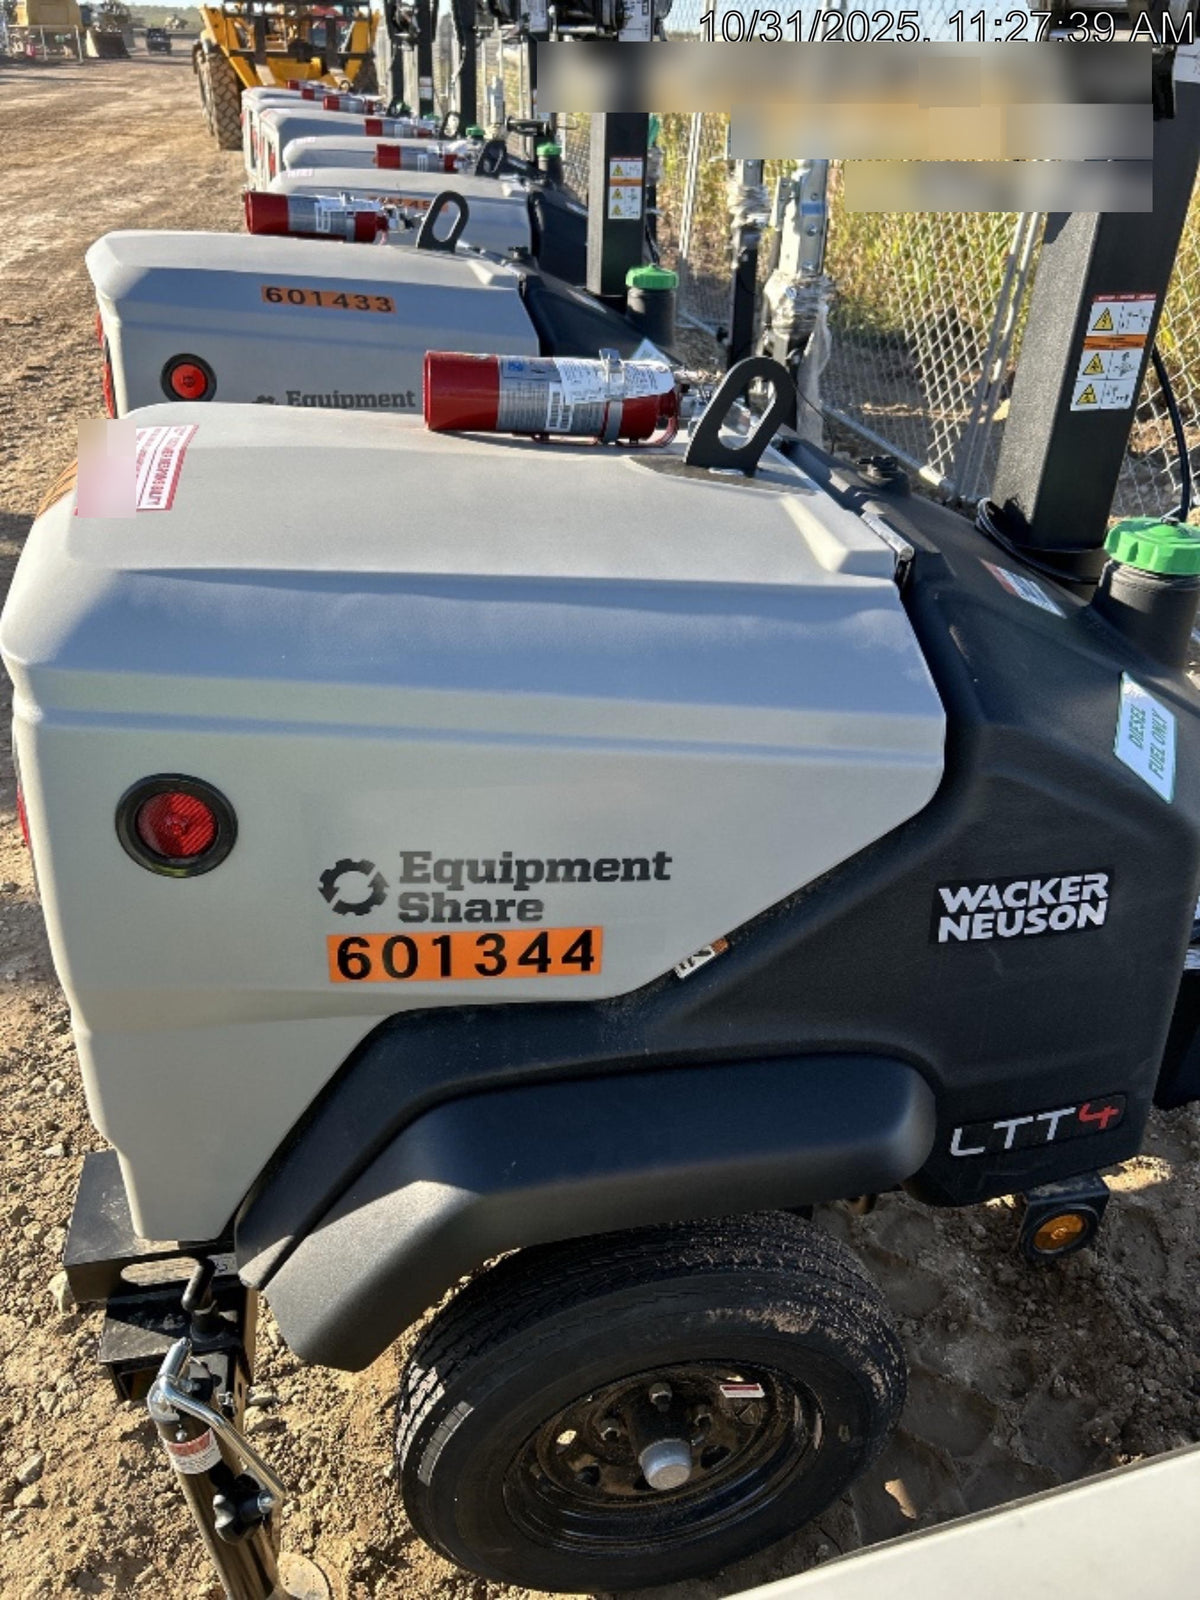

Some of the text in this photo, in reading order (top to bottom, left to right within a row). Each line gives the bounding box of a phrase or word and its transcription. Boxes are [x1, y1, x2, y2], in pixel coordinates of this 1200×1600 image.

[266, 287, 392, 313] 601433
[285, 389, 416, 409] Equipment
[1128, 703, 1146, 750] DIESEL
[1149, 708, 1168, 780] FUEL ONLY
[399, 851, 673, 891] Equipment
[398, 892, 545, 923] Share
[938, 872, 1109, 913] WACKER
[938, 899, 1108, 943] NEUSON
[336, 928, 595, 980] 601344
[950, 1103, 1120, 1157] LTT4
